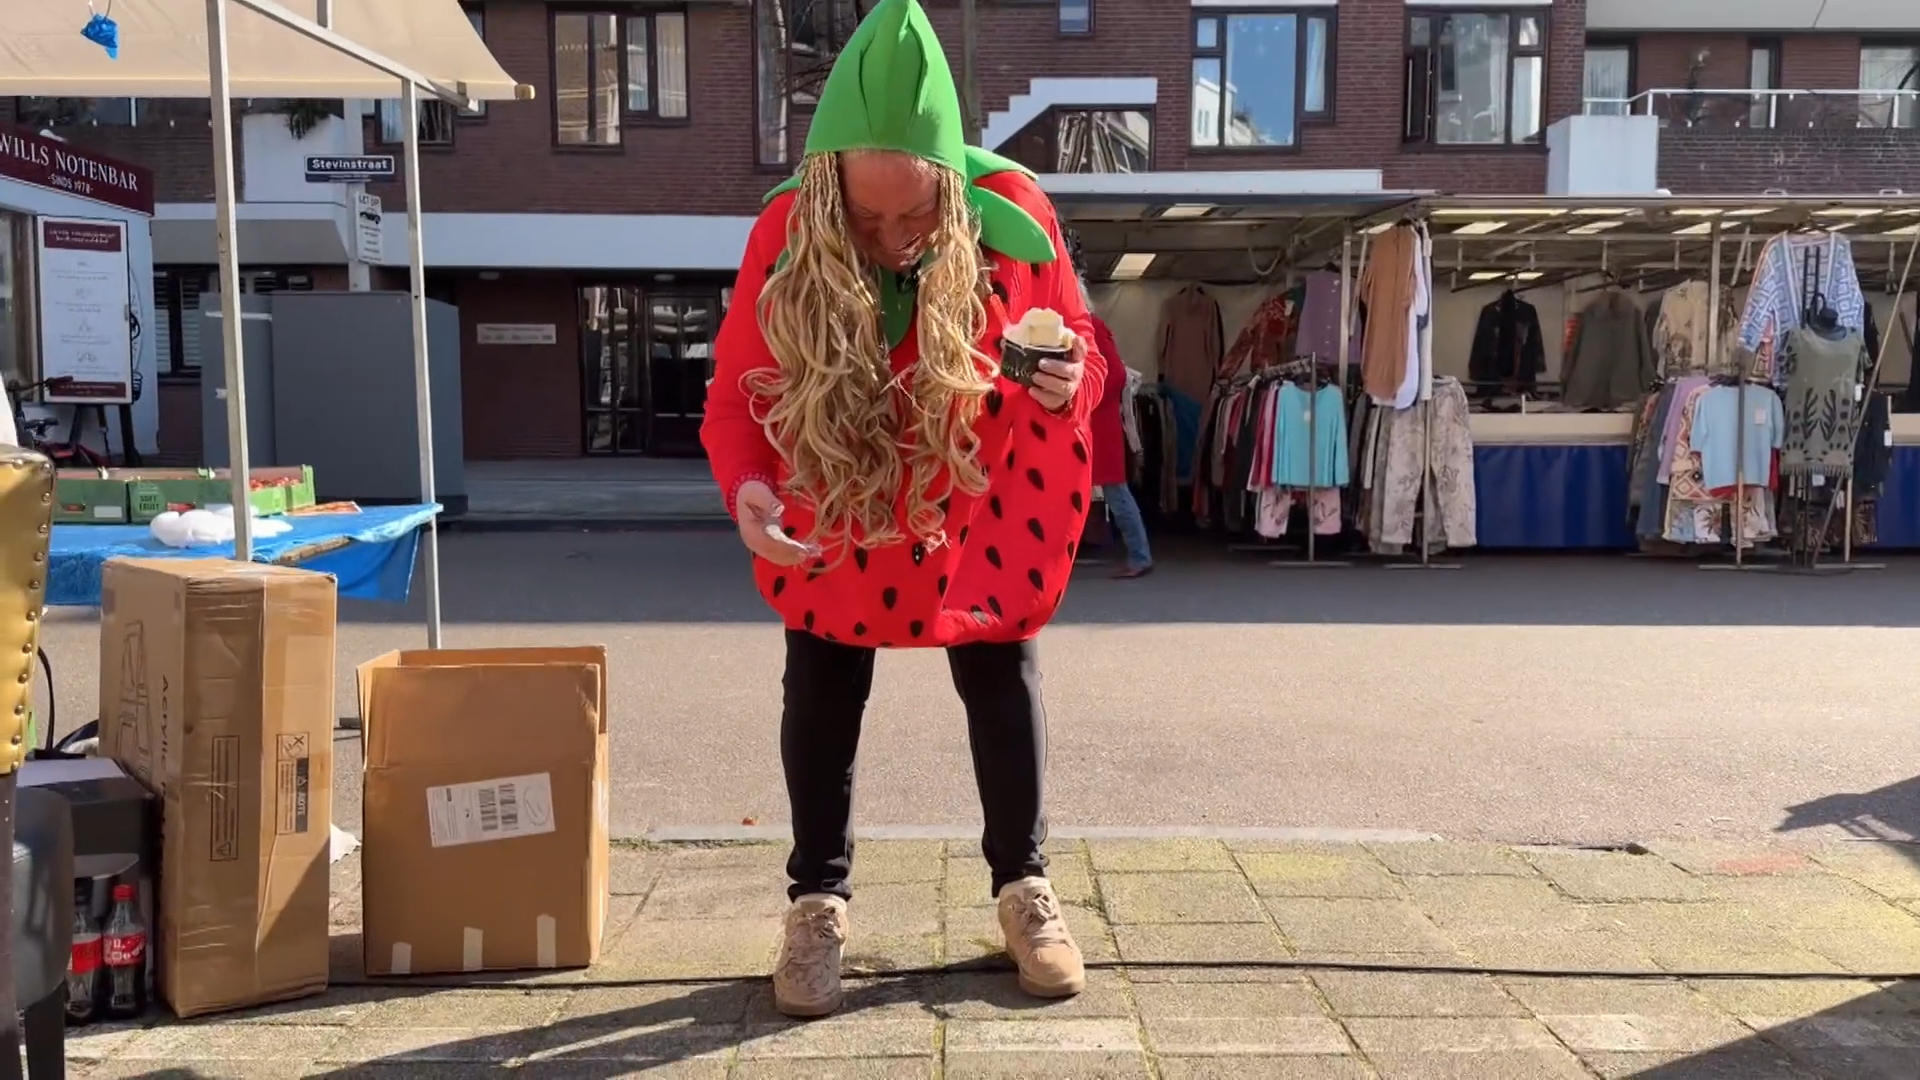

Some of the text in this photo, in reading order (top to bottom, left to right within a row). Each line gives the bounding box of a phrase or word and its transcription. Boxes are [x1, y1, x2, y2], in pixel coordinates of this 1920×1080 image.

[0, 133, 138, 191] WILLS NOTENBAR
[312, 158, 388, 169] Stevinstraat
